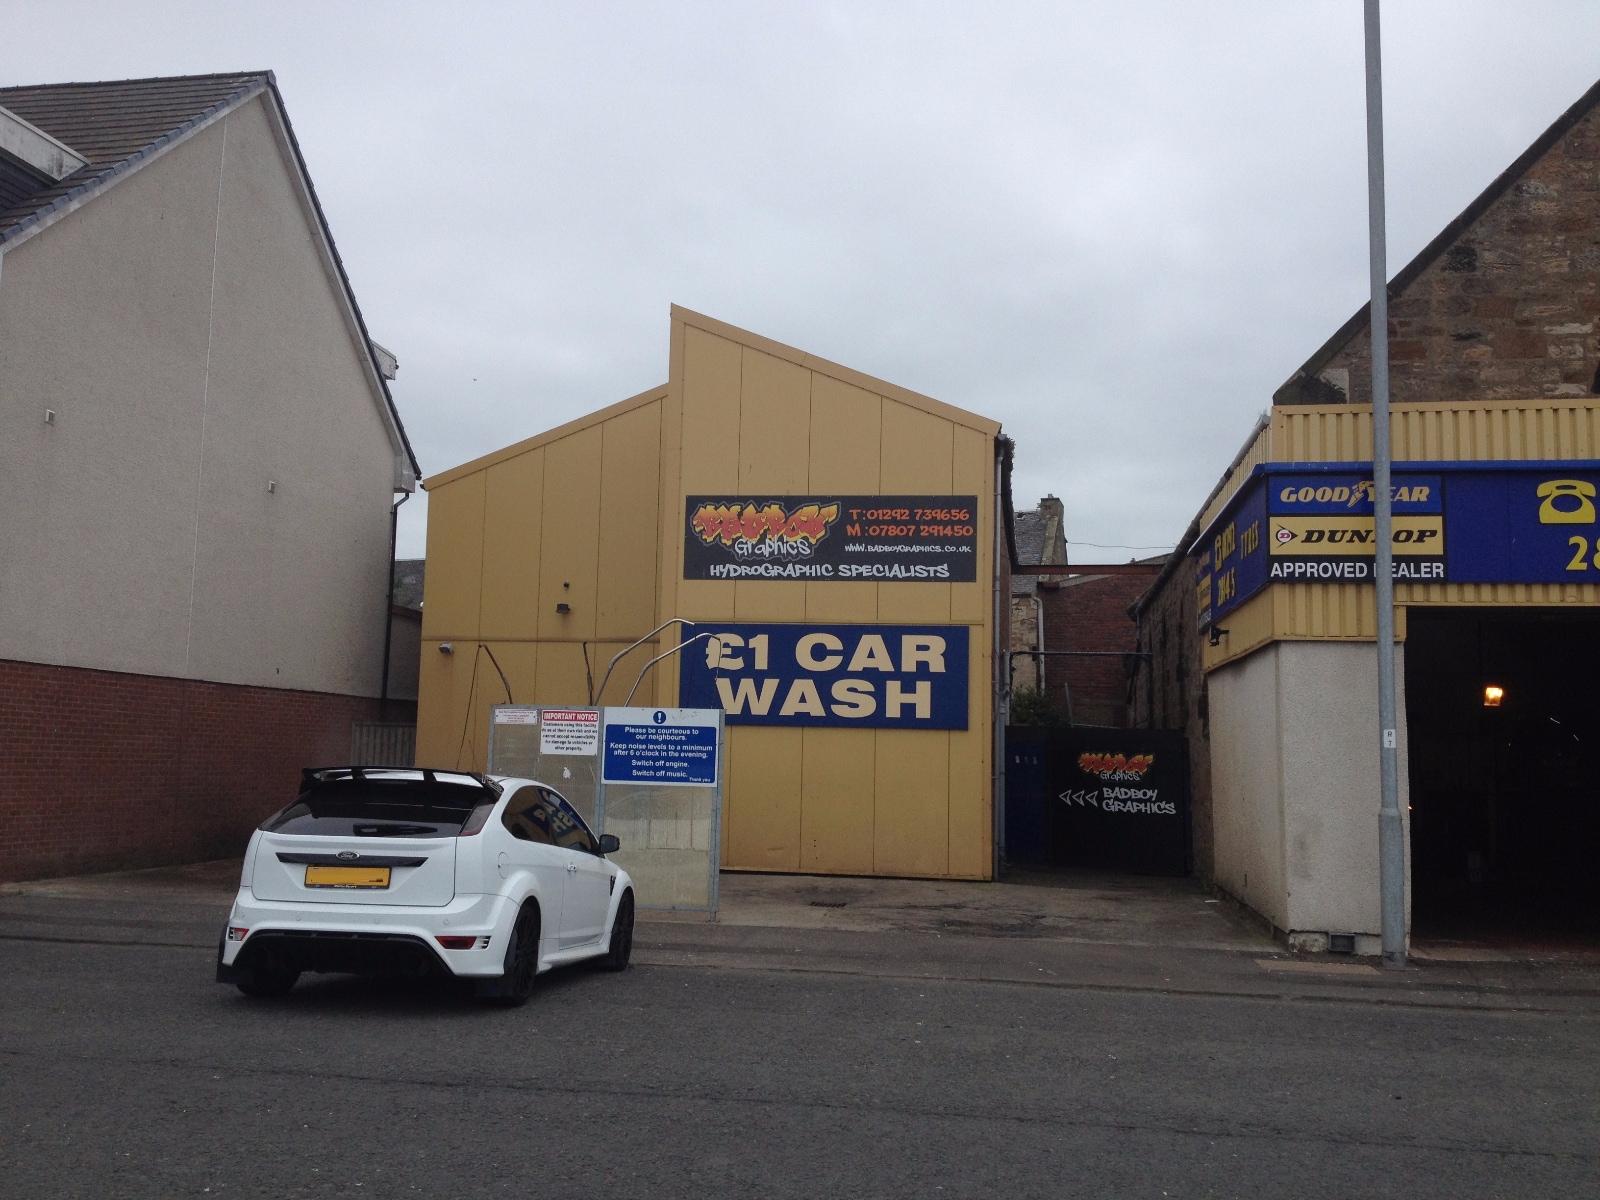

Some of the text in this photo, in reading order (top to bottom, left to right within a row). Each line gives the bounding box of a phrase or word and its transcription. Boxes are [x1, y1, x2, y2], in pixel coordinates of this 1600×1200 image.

[914, 508, 970, 520] 739656
[920, 525, 974, 537] 291450
[1301, 530, 1438, 543] DUNOP
[735, 534, 811, 557] Graphics
[710, 563, 950, 578] HYDROGRAPHIC SPECIALISTS
[1270, 563, 1444, 577] APPROVED EALER
[705, 633, 947, 673] £1 CAR
[715, 678, 931, 719] WASH
[543, 712, 598, 721] IMPORTANT NOTICE
[610, 742, 627, 750] Keep
[636, 749, 659, 757] o'clock
[680, 751, 708, 759] evening.
[631, 759, 654, 767] Switch
[1100, 770, 1140, 781] Graphics
[1103, 787, 1158, 801] BADBOY
